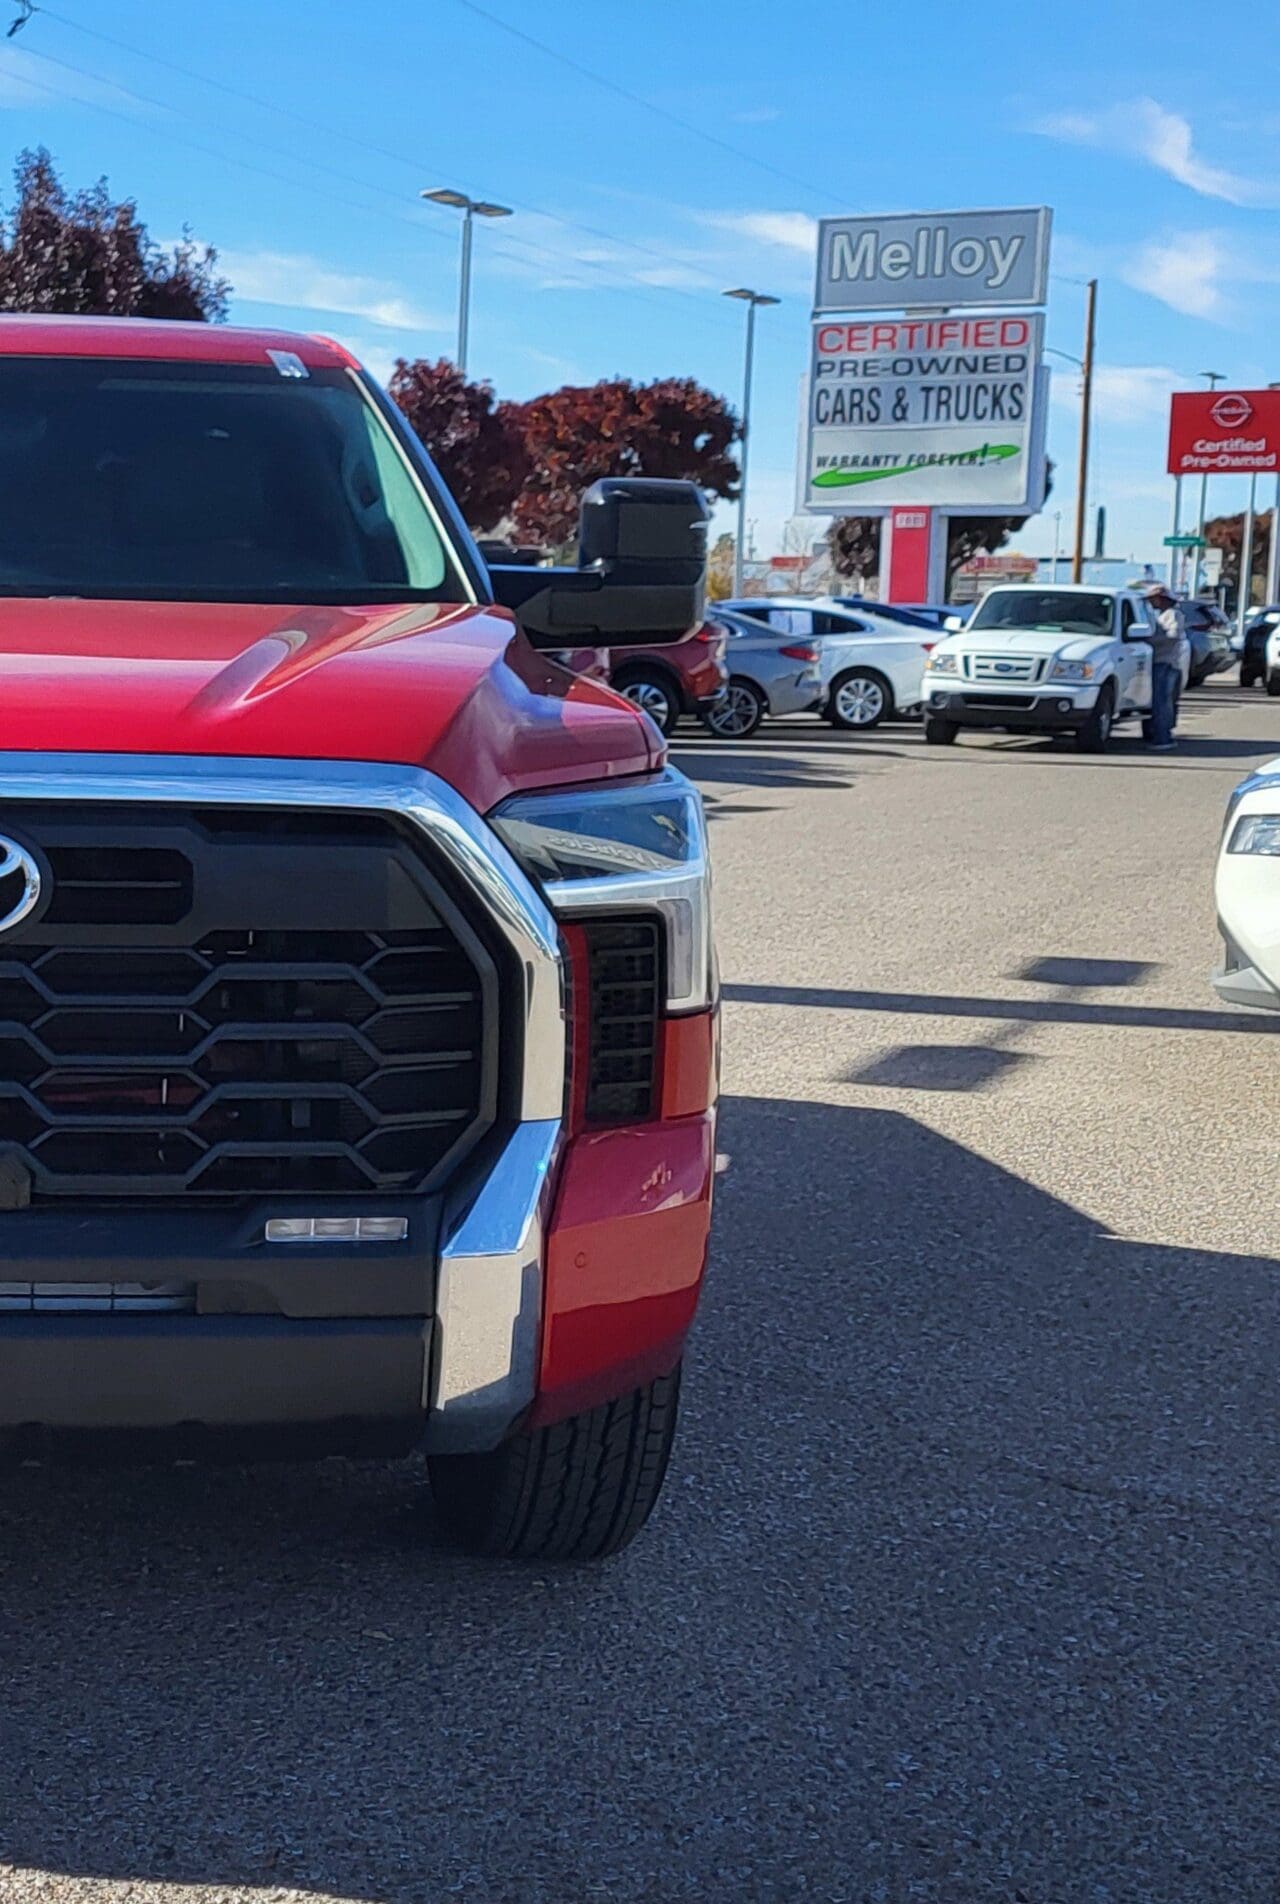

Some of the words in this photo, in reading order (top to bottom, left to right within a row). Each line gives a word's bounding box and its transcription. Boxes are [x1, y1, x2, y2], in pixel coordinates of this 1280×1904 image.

[829, 227, 1025, 288] Melloy
[817, 319, 1029, 353] CERTIFIED
[815, 354, 1027, 378] PRE-OWNED
[815, 387, 881, 425] CARS
[891, 386, 909, 422] &
[921, 382, 1024, 422] TRUCKS
[1193, 437, 1266, 453] Certified
[816, 453, 900, 468] WARRANTY
[1181, 452, 1277, 468] Pre-Owned
